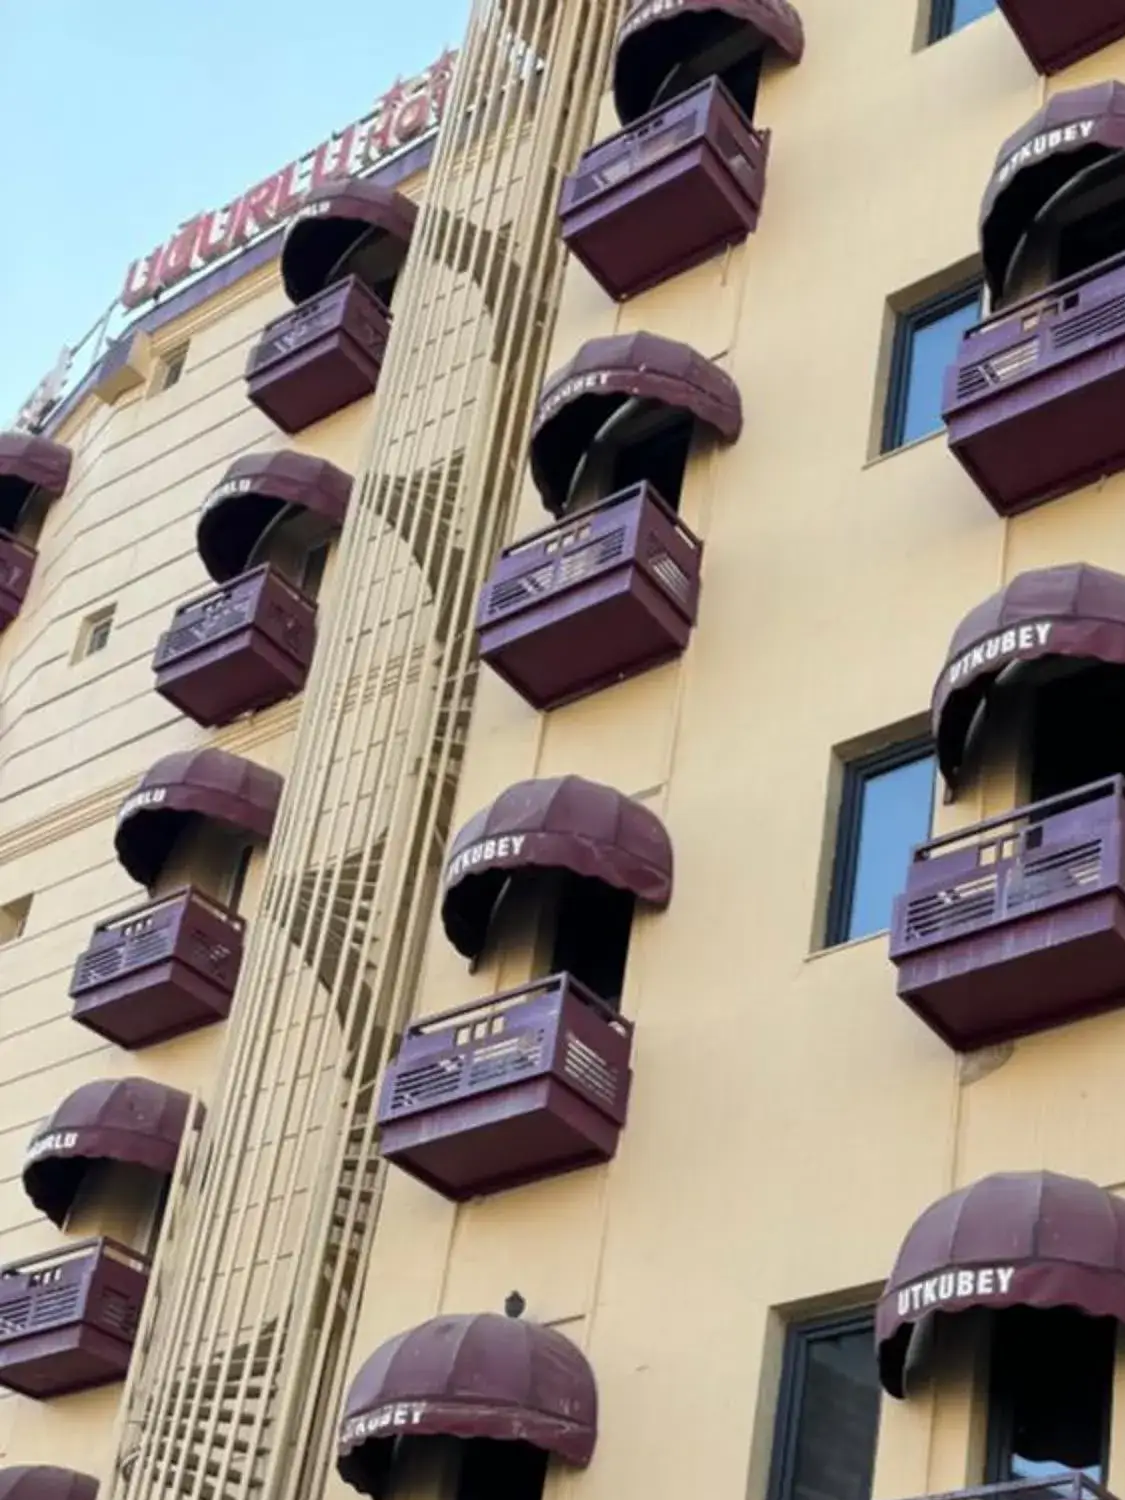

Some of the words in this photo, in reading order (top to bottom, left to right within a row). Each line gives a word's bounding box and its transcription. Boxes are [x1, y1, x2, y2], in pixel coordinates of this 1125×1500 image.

[998, 119, 1095, 182] UTKUBEY
[949, 622, 1053, 683] UTKUBEY
[897, 1266, 1015, 1316] UTKUBEY
